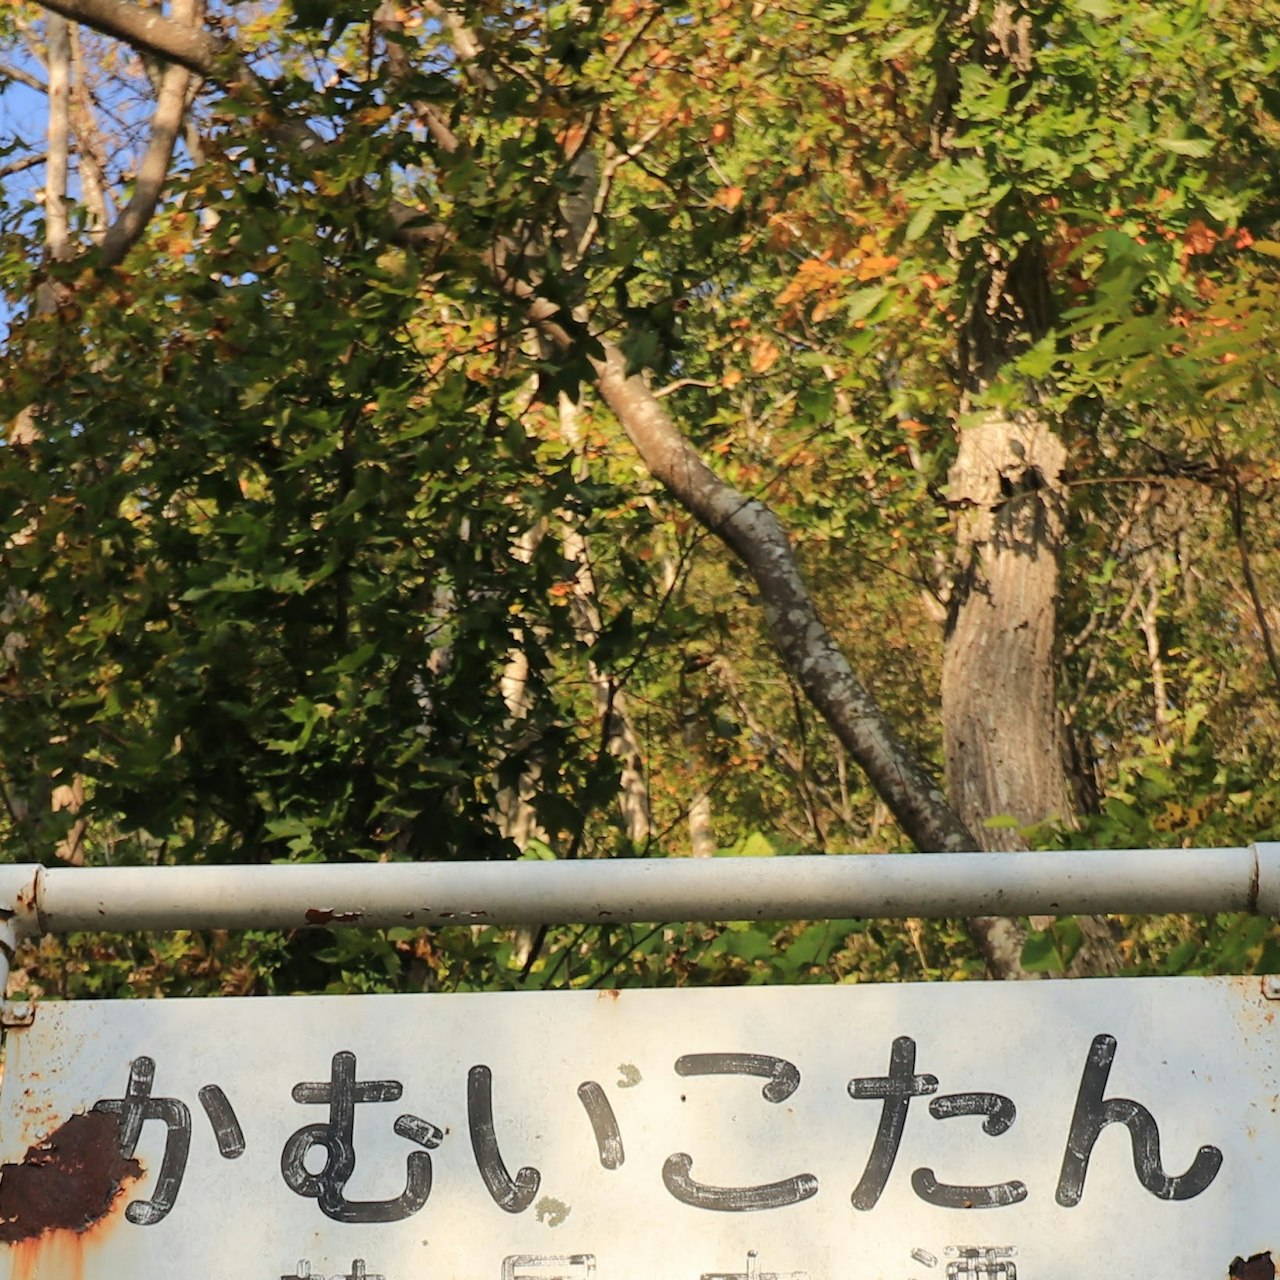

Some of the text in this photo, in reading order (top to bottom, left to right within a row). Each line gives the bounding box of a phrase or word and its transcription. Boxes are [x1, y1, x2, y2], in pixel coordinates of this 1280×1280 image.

[93, 1033, 1224, 1225] かむいこたん
